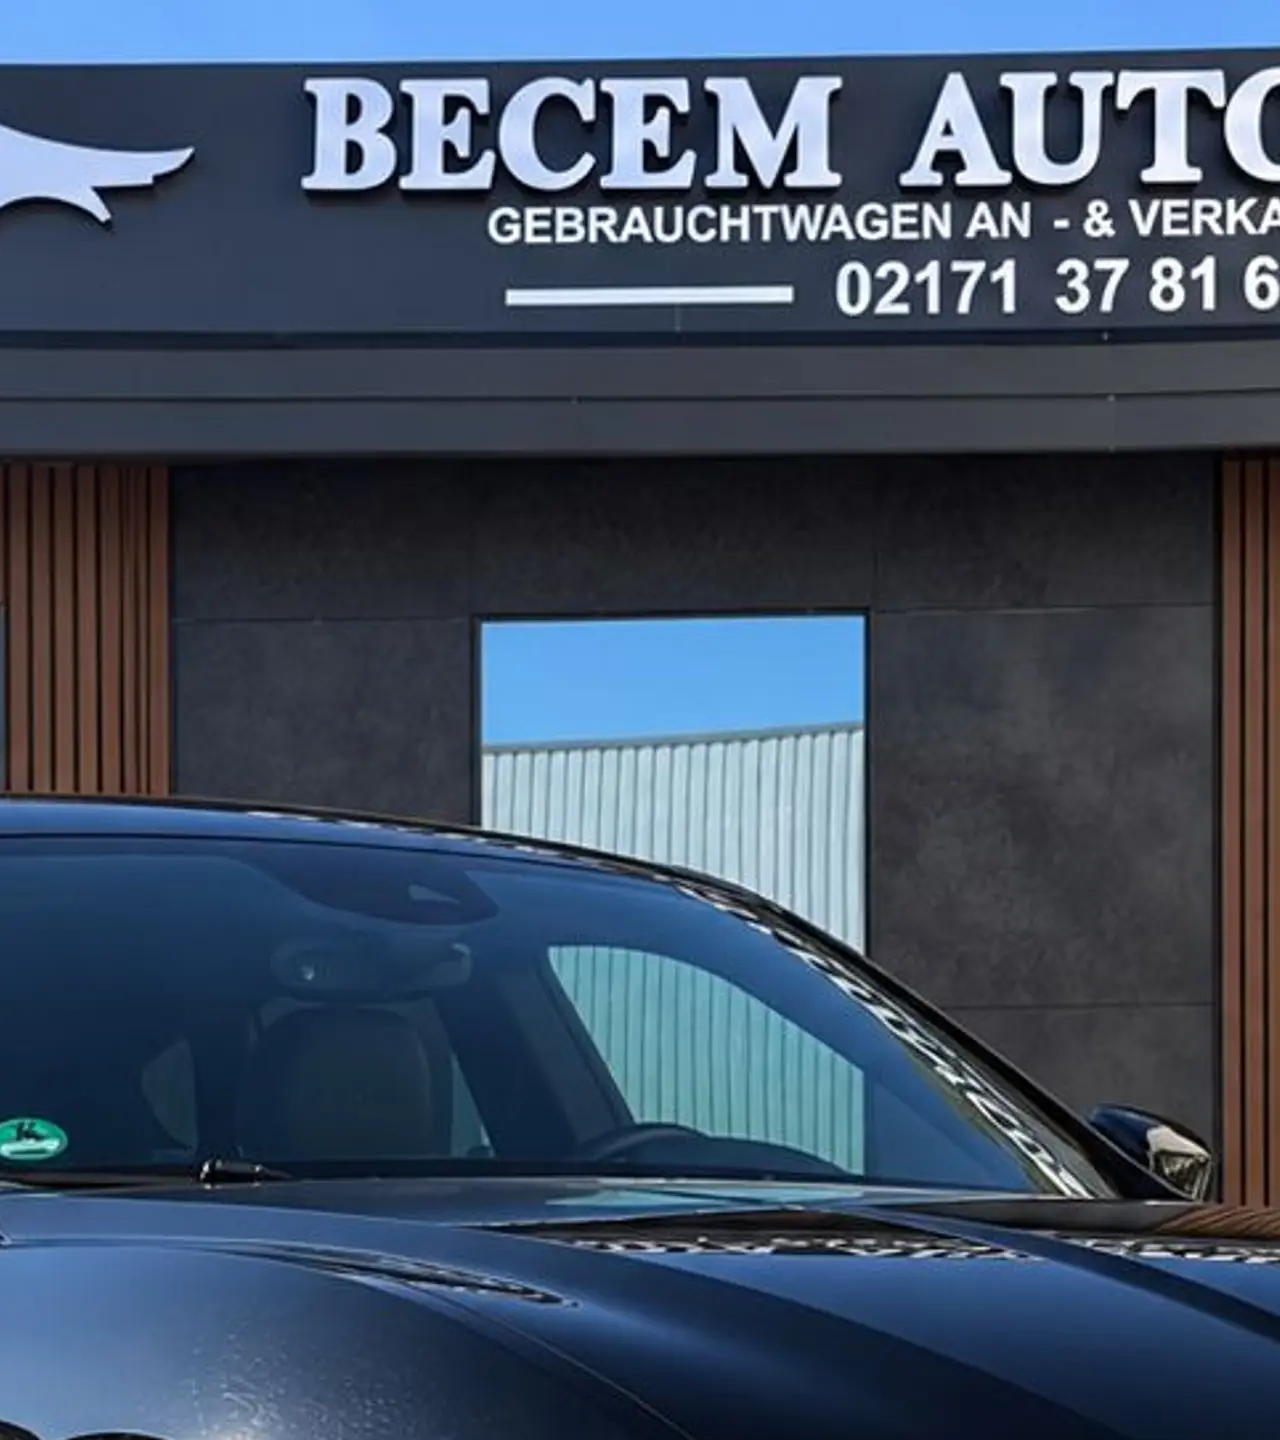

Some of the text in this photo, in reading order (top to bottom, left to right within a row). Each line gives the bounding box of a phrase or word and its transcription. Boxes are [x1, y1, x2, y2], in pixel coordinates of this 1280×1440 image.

[301, 76, 844, 191] BECEM
[487, 201, 953, 245] GEBRAUCHTWAGEN
[964, 201, 1032, 240] AN
[1082, 199, 1117, 239] &
[835, 259, 1017, 317] 02171
[1054, 257, 1131, 315] 37
[1148, 255, 1217, 313] 81
